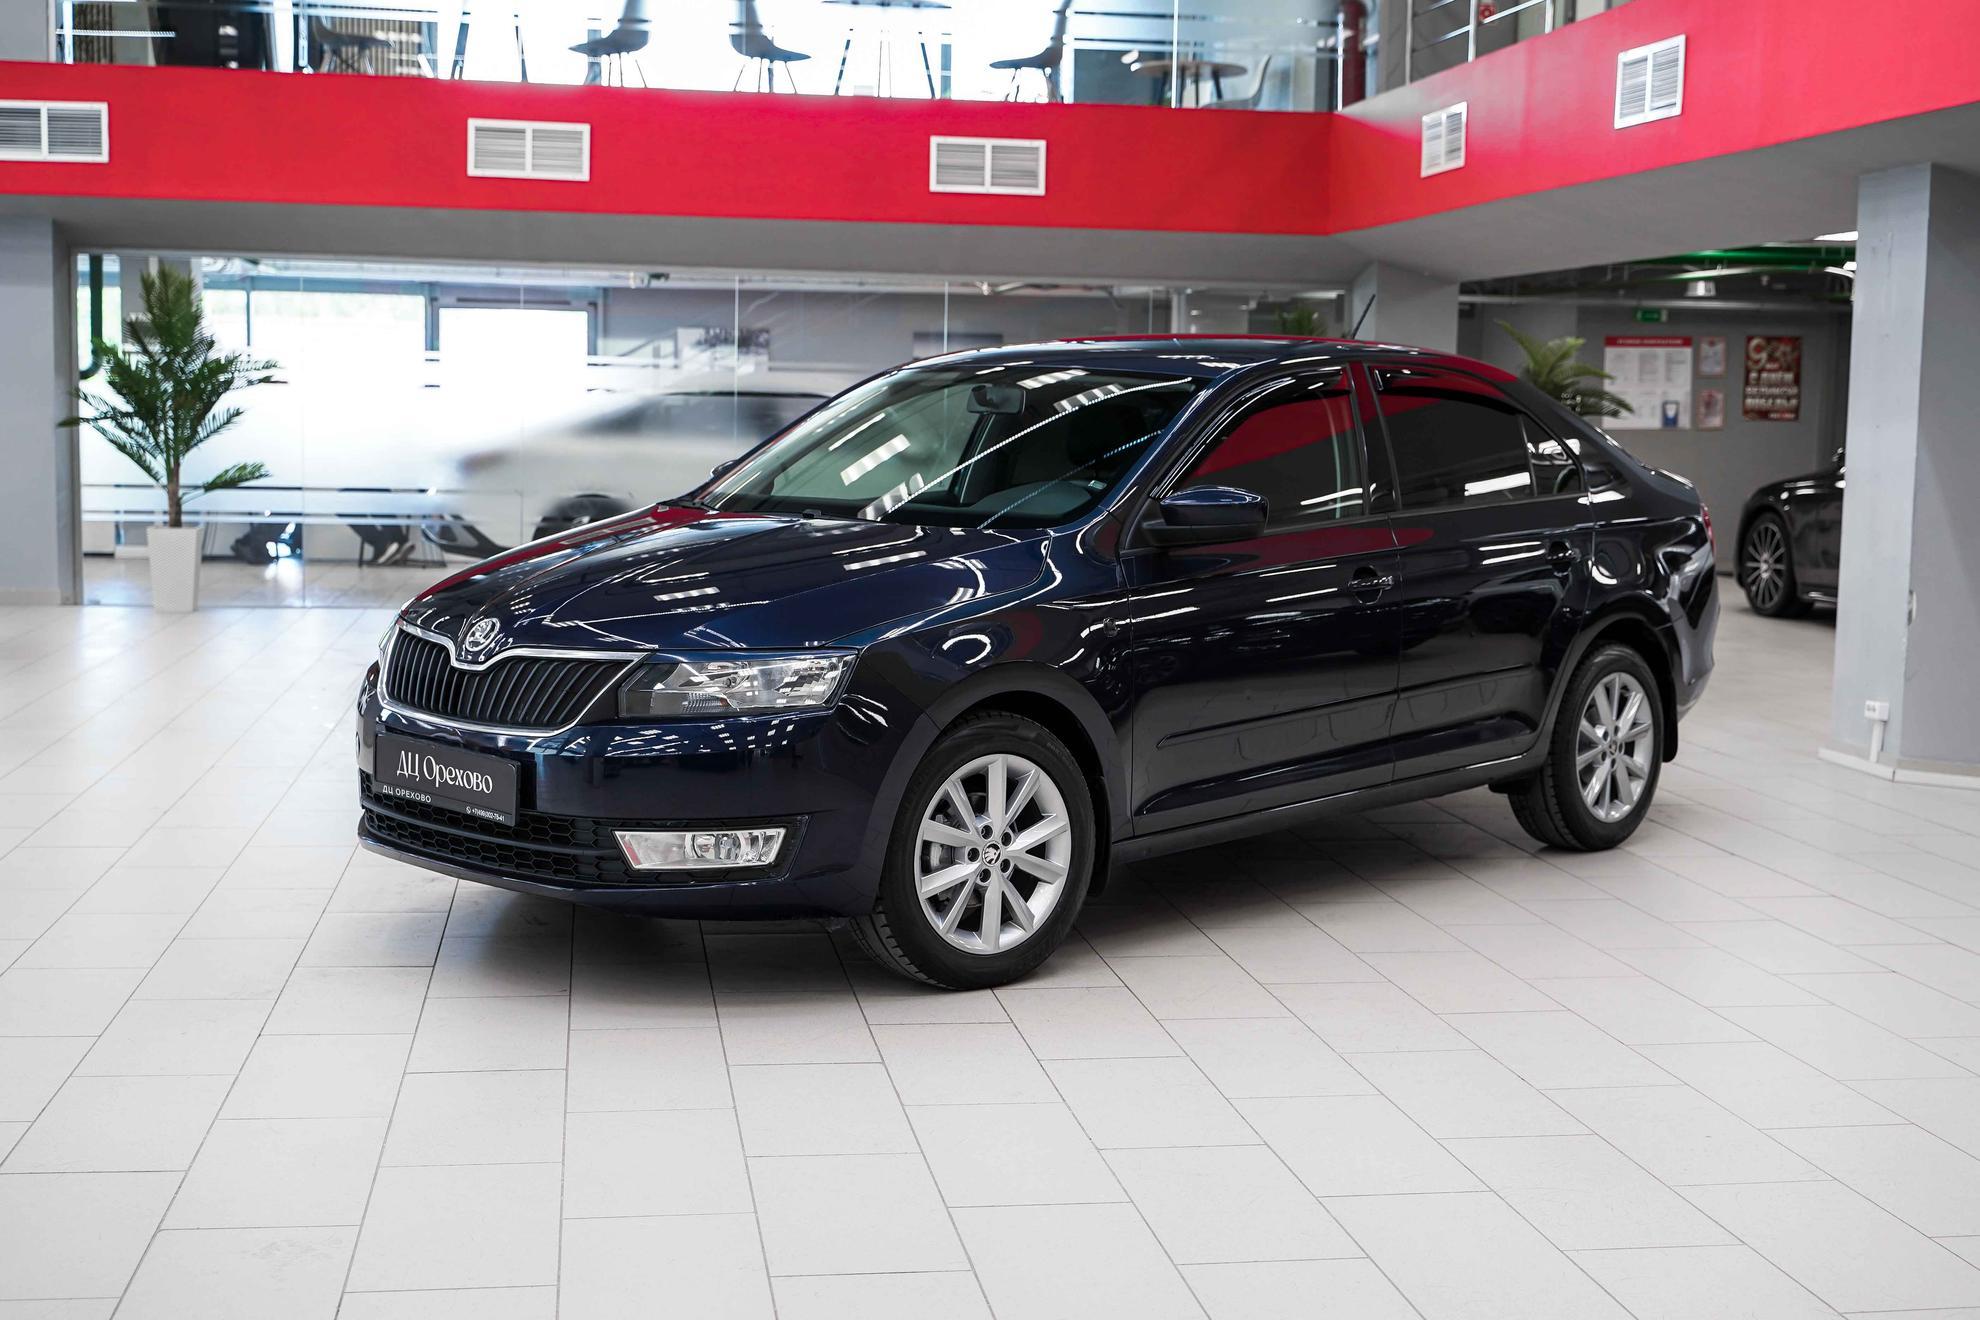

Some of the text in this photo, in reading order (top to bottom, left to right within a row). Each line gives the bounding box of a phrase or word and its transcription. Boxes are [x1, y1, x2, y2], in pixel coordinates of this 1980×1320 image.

[396, 750, 493, 794] ДЦ Орехово
[382, 785, 432, 803] ДЦ ОРЕХОВО
